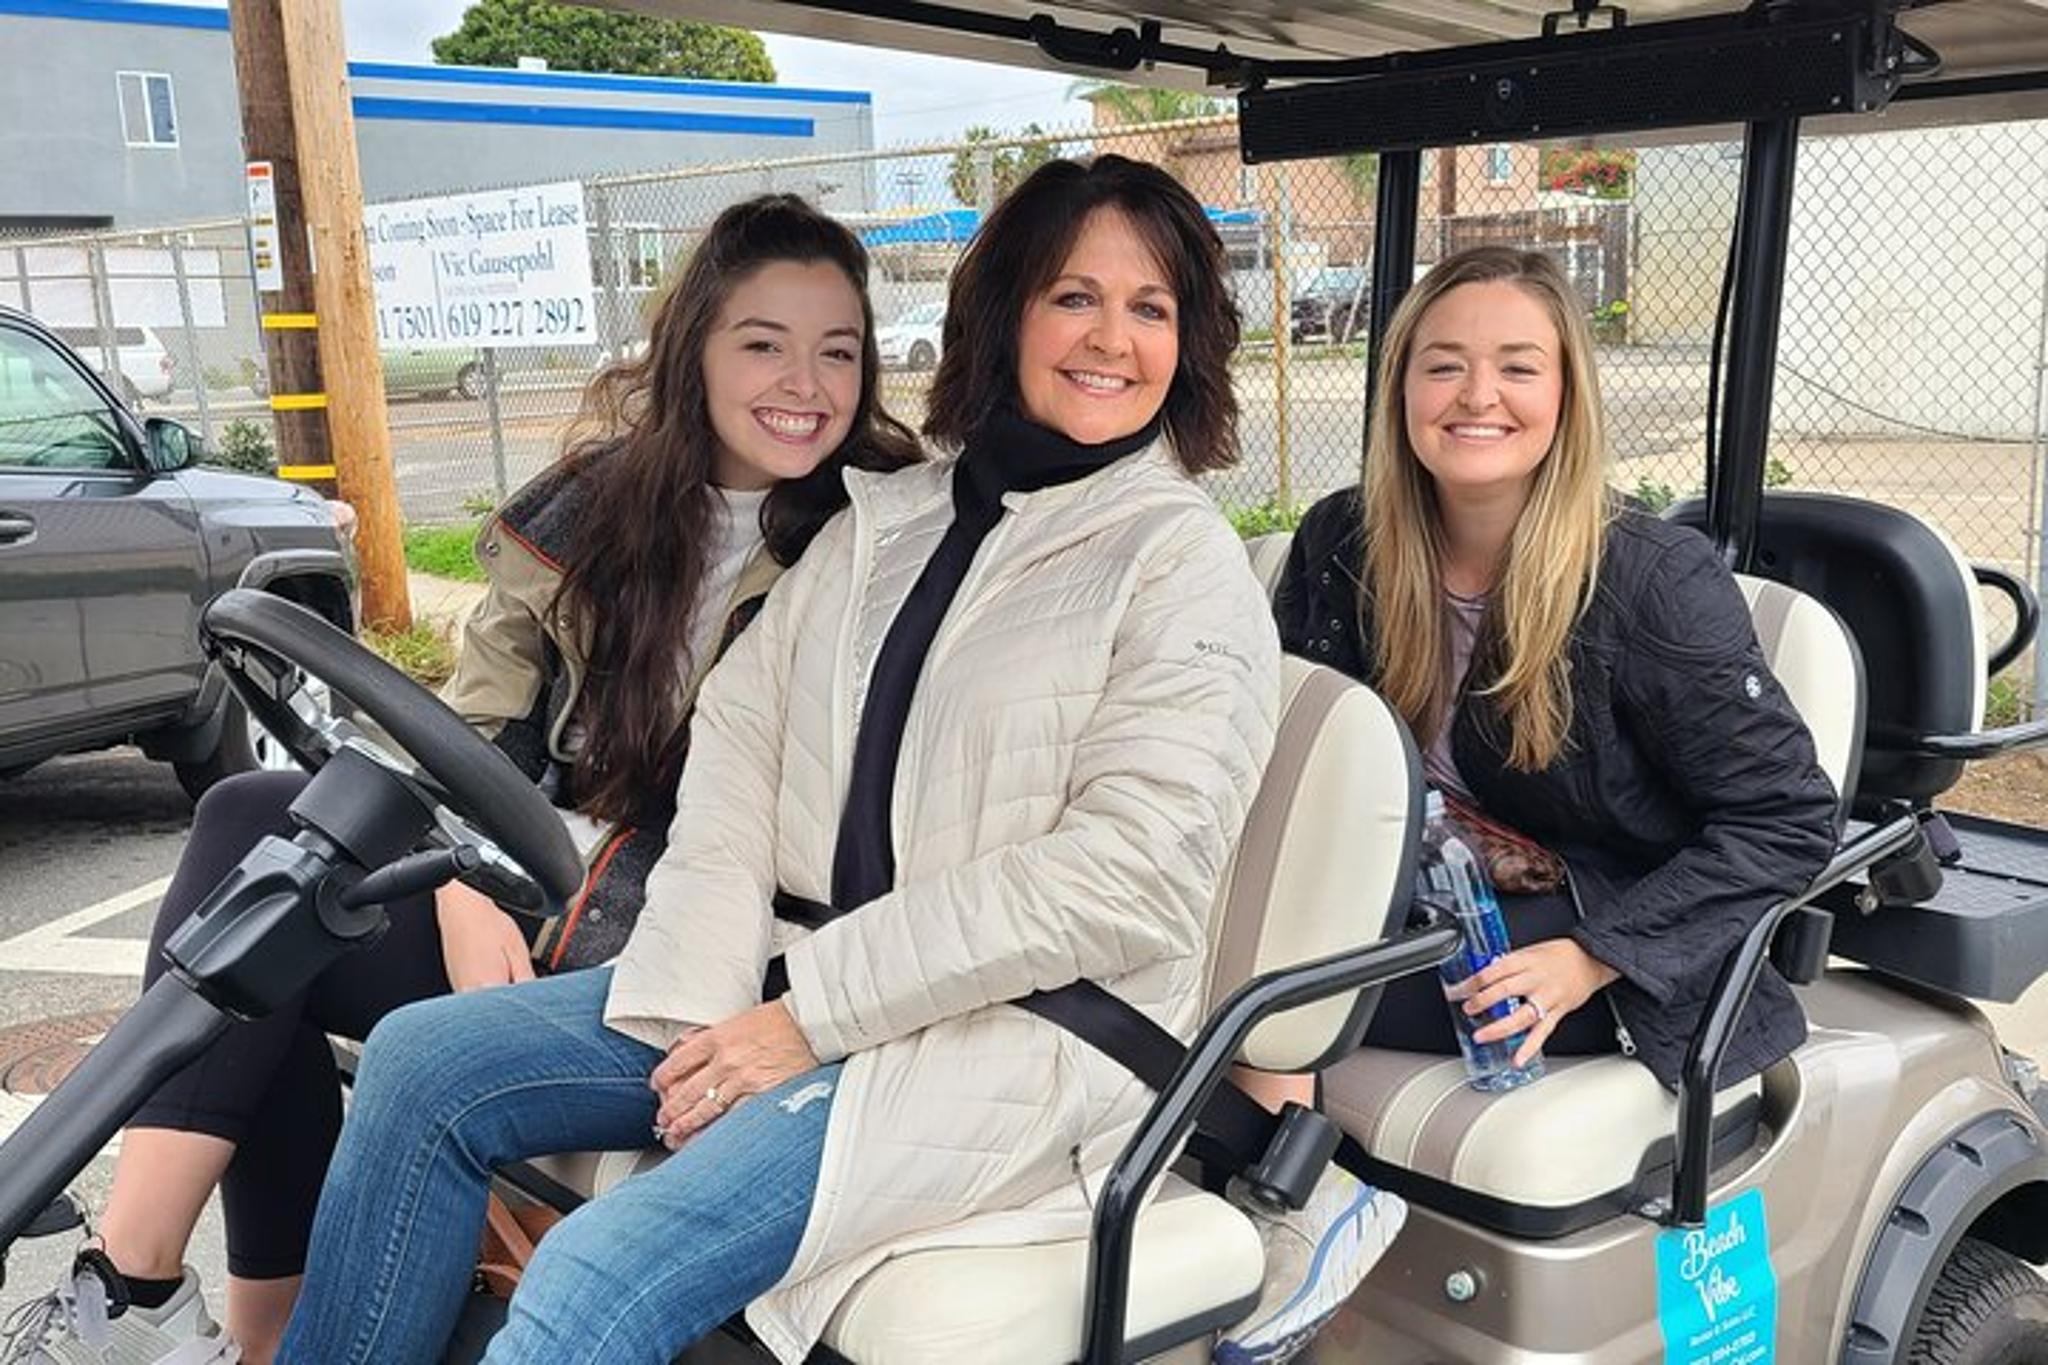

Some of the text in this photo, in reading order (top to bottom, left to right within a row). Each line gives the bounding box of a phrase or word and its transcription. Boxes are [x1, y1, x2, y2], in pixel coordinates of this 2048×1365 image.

[378, 211, 425, 247] Coming
[426, 207, 459, 240] Soon
[466, 203, 507, 240] Space
[509, 199, 534, 231] For
[536, 196, 579, 227] Lease
[371, 265, 397, 282] son
[440, 239, 556, 283] Vic Gausepohl
[392, 305, 437, 340] 7501
[447, 297, 586, 337] 619 227 2892
[1680, 1211, 1746, 1281] Beach
[1694, 1264, 1741, 1323] Vibe
